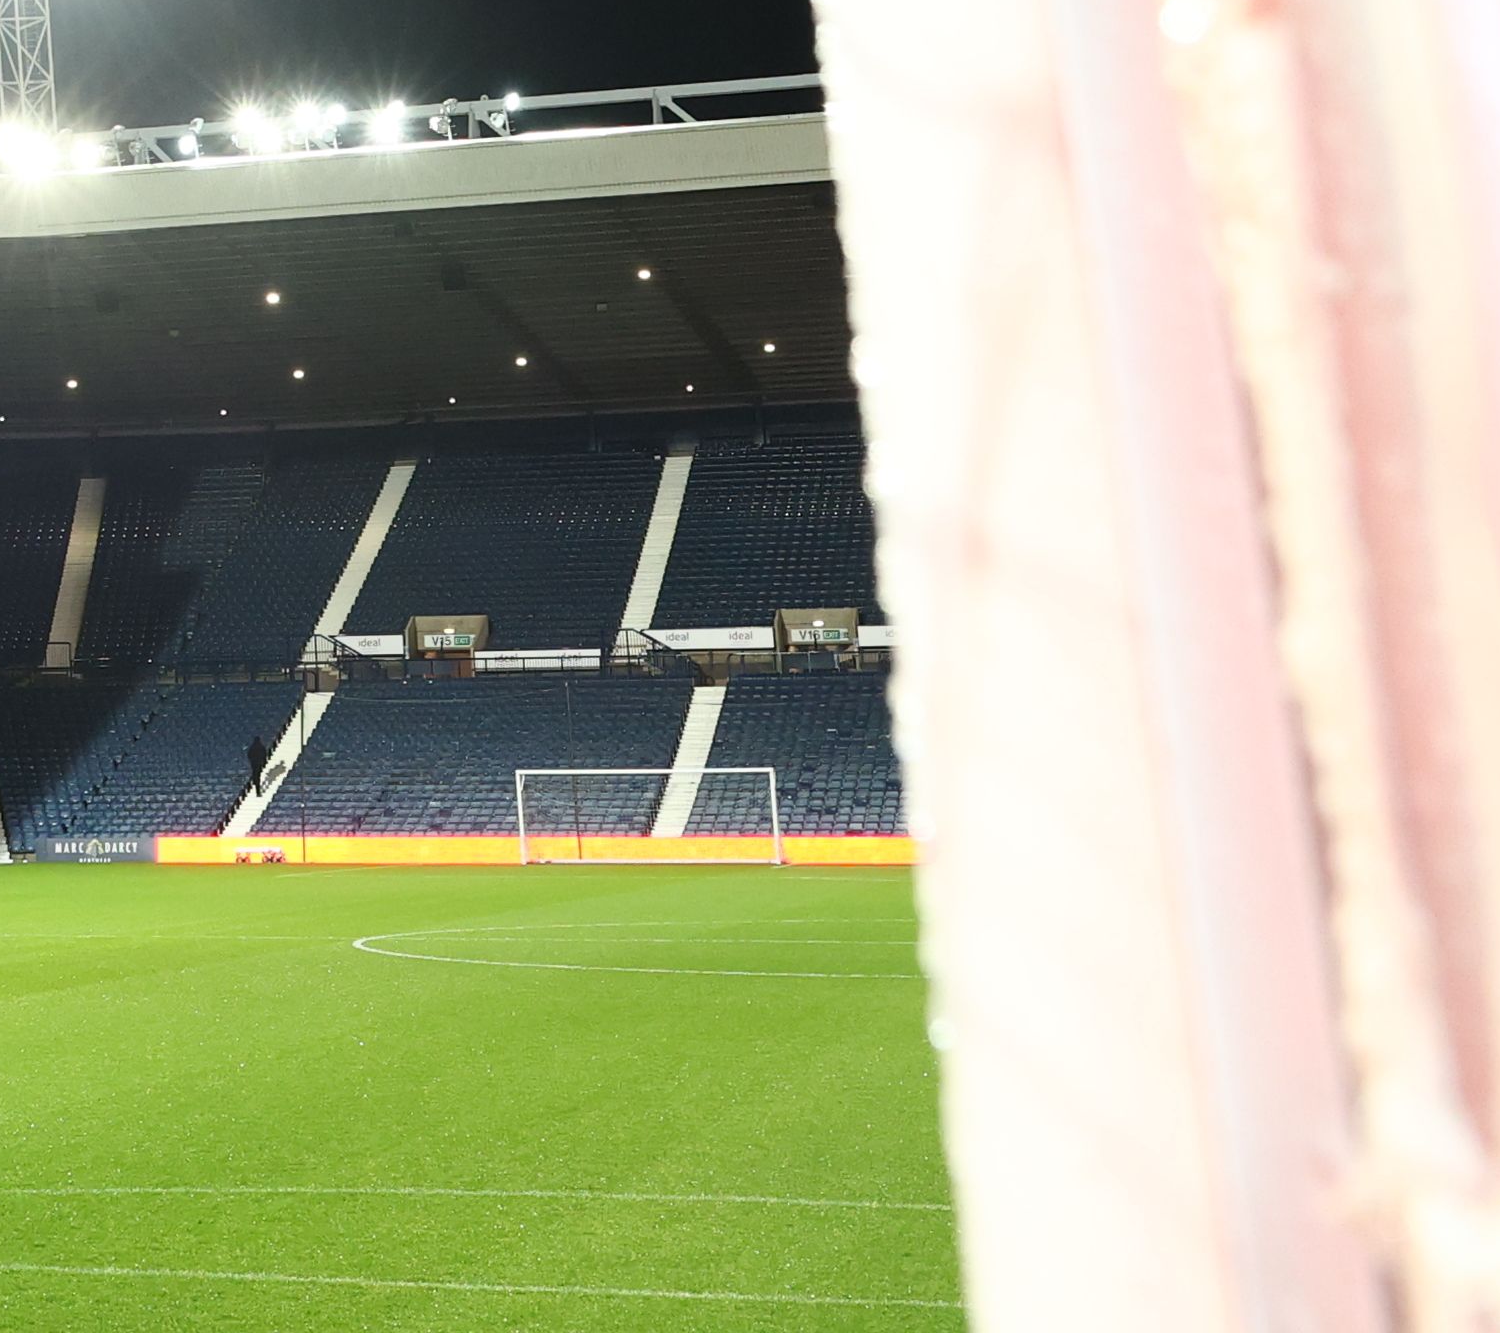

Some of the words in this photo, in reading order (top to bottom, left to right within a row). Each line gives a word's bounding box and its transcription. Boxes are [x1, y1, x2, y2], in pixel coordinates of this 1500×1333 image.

[665, 632, 689, 641] ideal
[729, 631, 753, 640] ideal
[358, 638, 381, 647] ideal
[55, 842, 84, 853] MARC
[105, 842, 138, 853] DARCY
